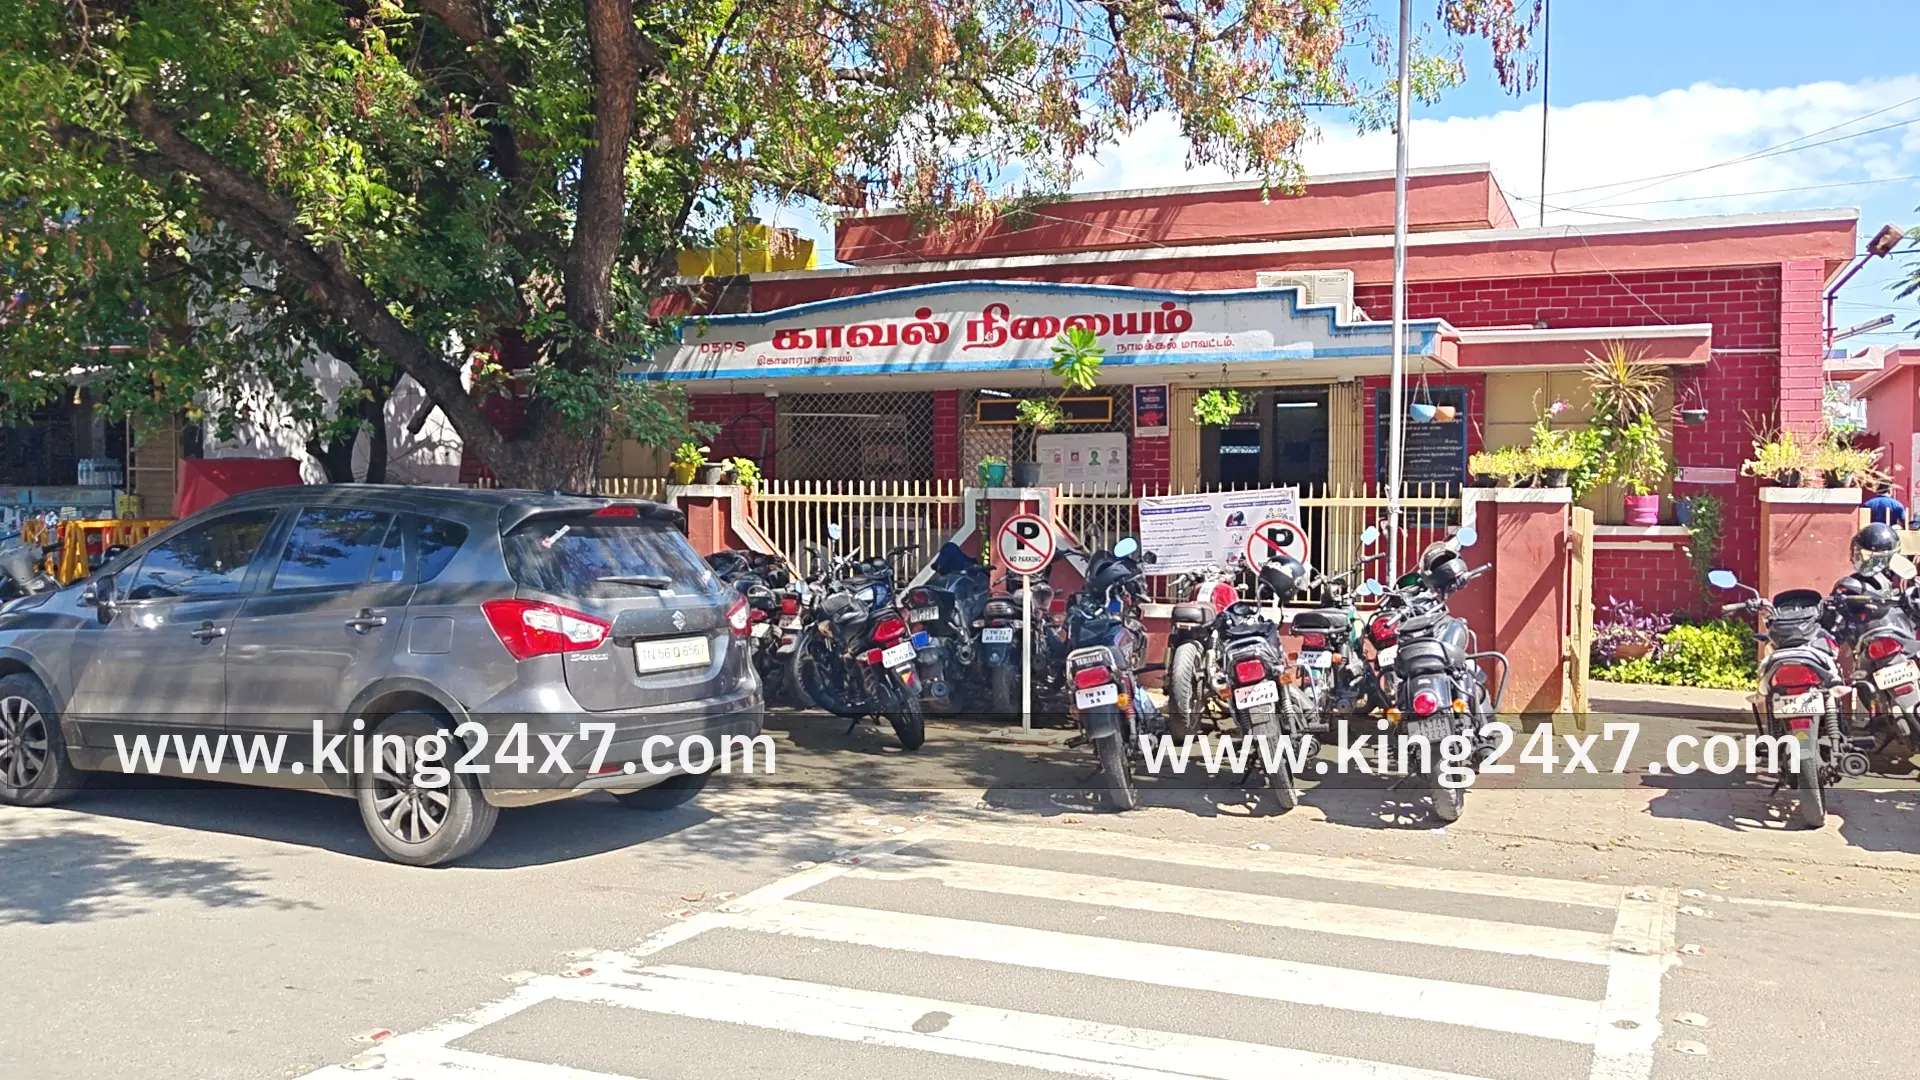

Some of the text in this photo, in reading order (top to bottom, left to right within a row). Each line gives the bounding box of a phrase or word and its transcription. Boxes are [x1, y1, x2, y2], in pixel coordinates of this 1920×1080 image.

[772, 301, 1193, 351] காவல் நிலையம்
[1116, 338, 1177, 354] நாமக்கல்
[1017, 522, 1040, 550] P
[1267, 528, 1294, 558] P
[1019, 555, 1042, 563] PARKING
